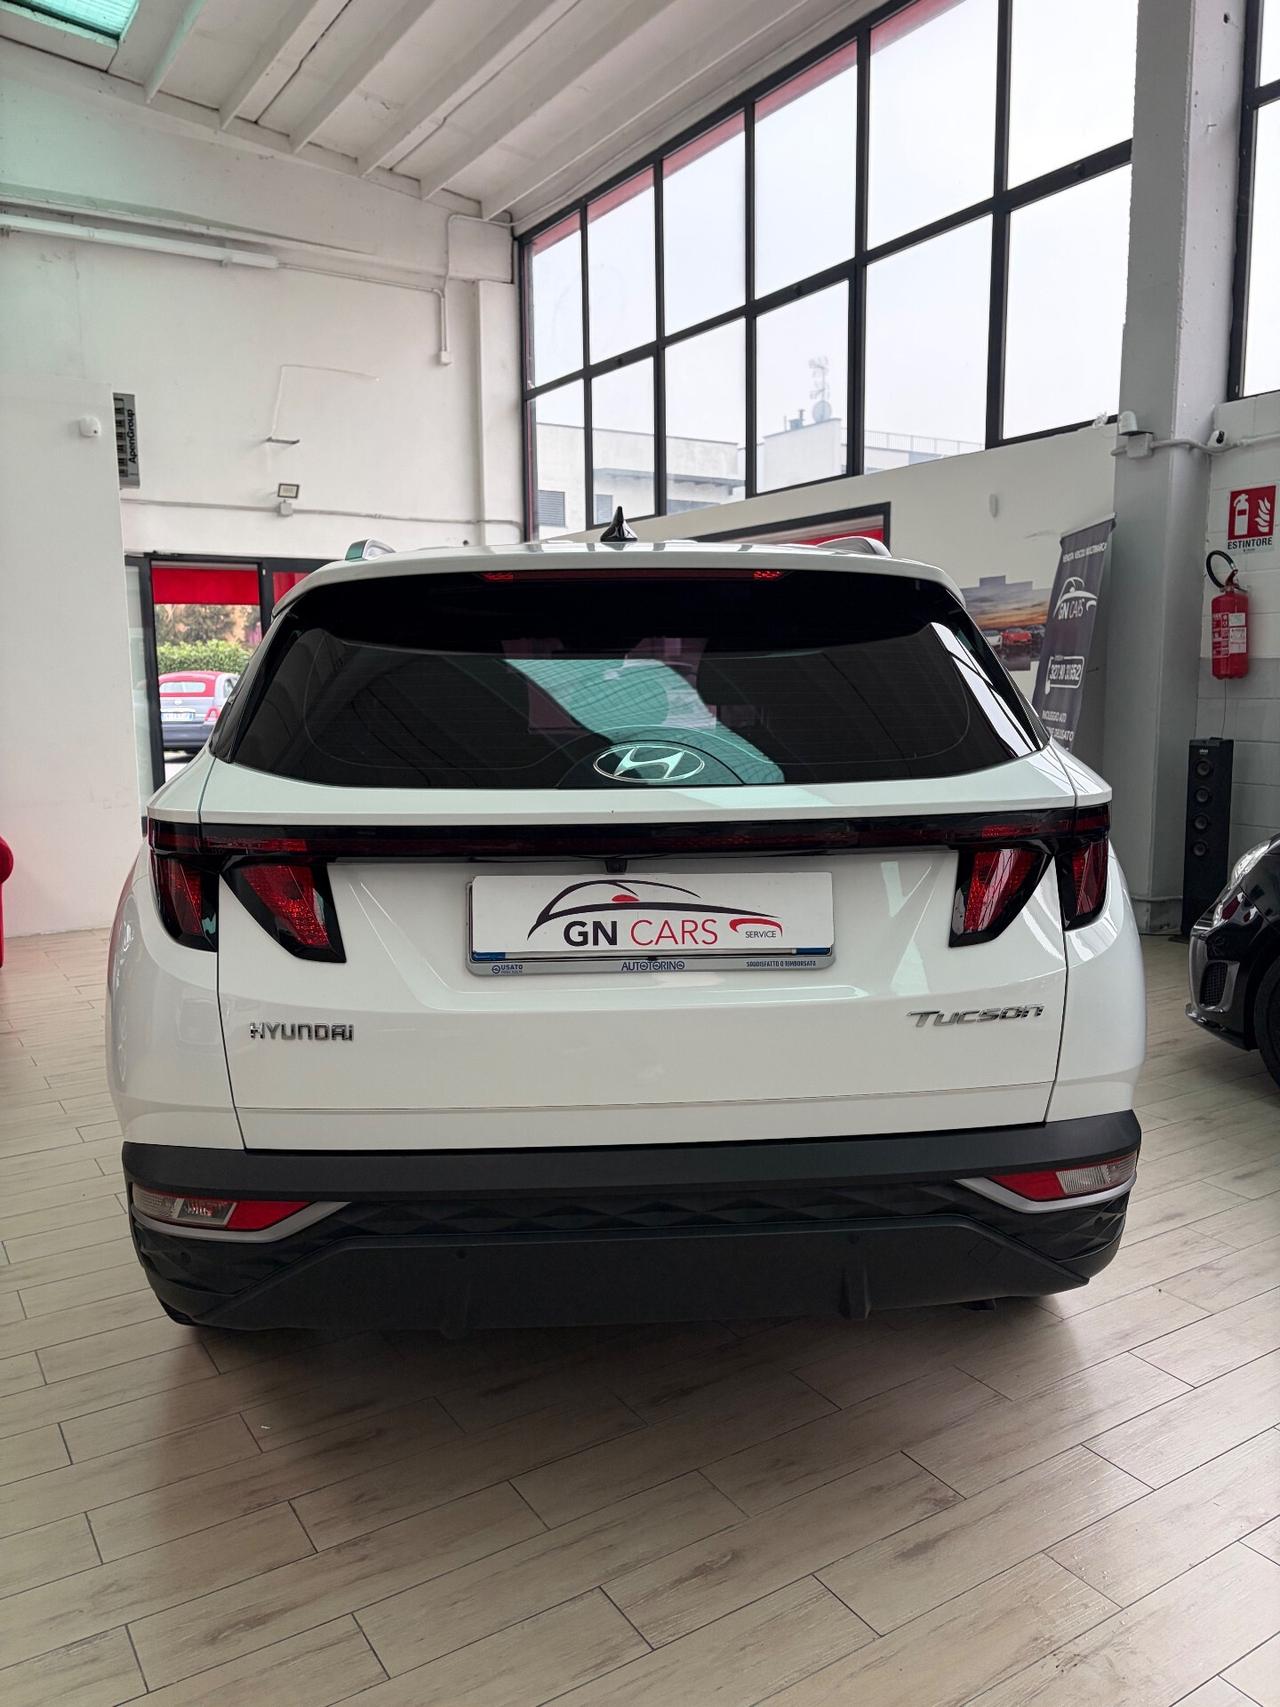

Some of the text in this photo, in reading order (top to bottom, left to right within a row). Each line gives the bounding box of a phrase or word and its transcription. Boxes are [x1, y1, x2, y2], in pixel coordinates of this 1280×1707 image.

[127, 409, 138, 464] ApenGroup
[1227, 537, 1273, 550] ESTINTORE
[563, 918, 718, 947] GN CARS
[745, 930, 777, 939] SERVICE
[621, 960, 685, 971] AUTOTORINO
